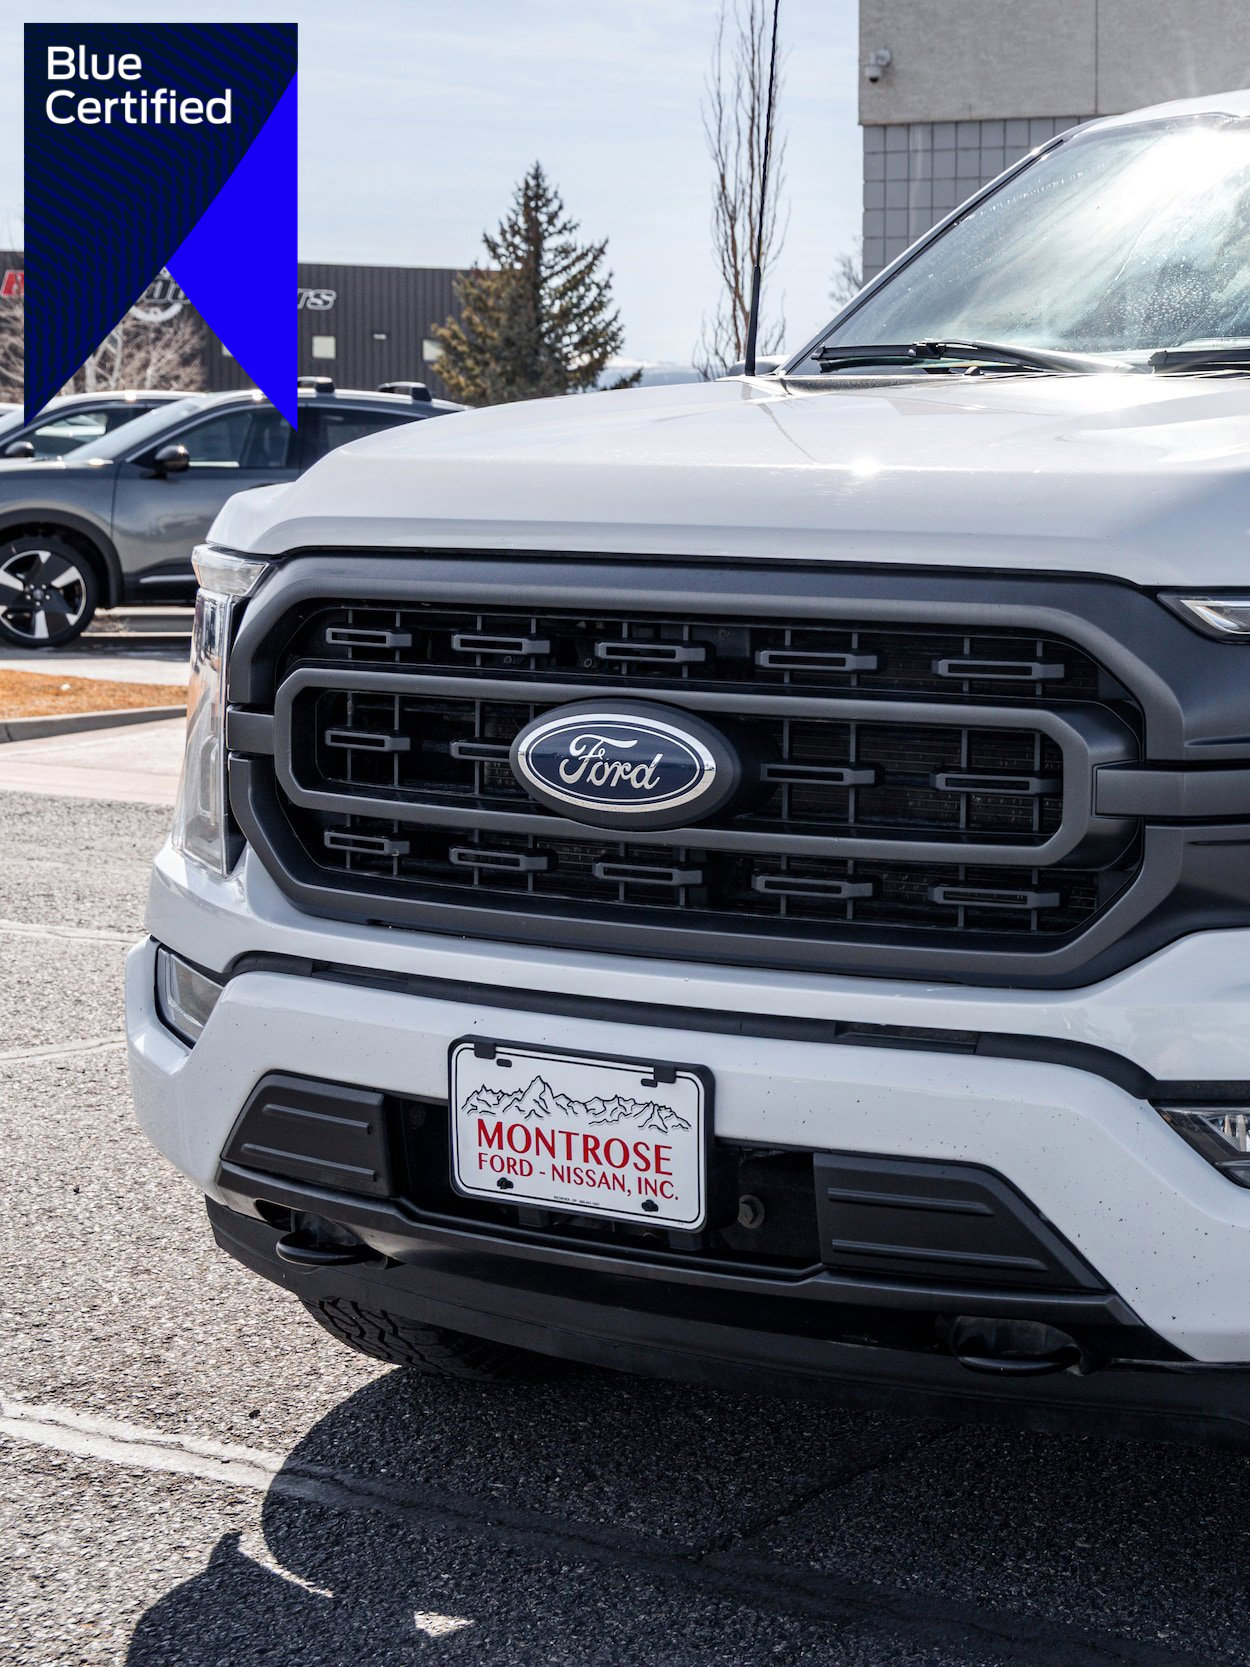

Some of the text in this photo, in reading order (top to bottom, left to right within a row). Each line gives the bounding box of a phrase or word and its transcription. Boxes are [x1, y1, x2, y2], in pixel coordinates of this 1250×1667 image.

[559, 733, 663, 790] Ford
[477, 1118, 673, 1176] MONTROSE
[478, 1152, 534, 1177] FORD
[551, 1163, 632, 1197] NISSAN,
[637, 1176, 679, 1201] INC.
